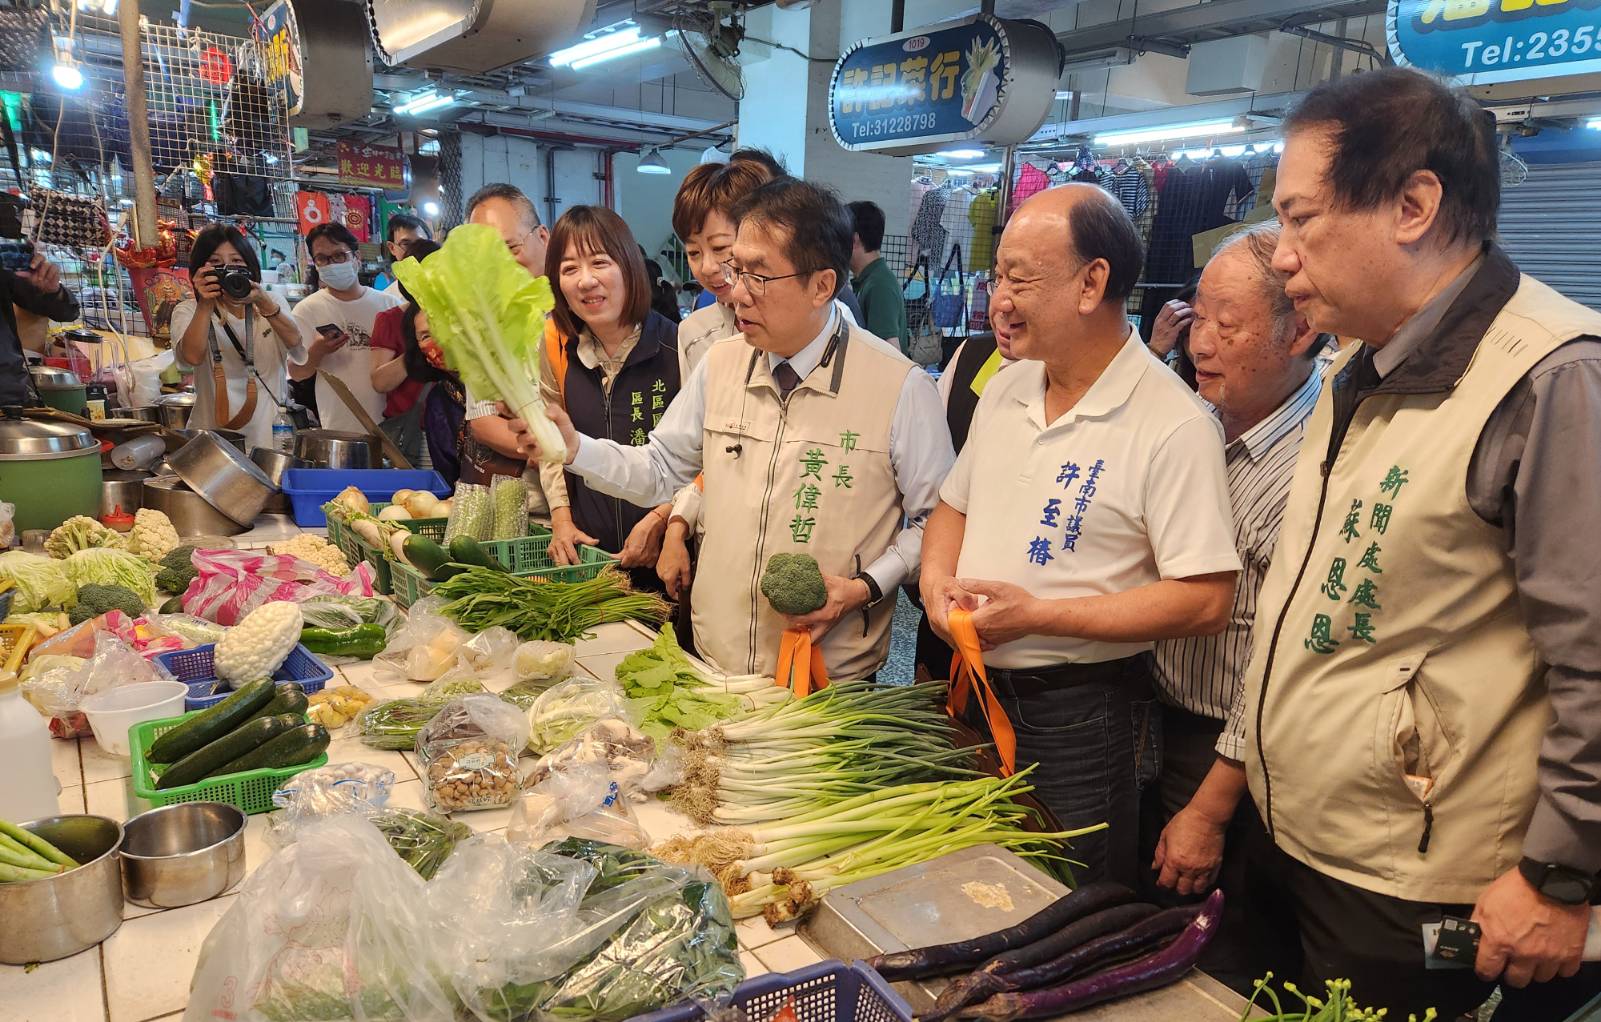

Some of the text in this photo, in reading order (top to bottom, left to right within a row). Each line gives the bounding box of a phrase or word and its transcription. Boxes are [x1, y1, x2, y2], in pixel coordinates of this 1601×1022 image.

[842, 51, 961, 113] 許記菜行
[908, 39, 925, 49] 1019
[852, 112, 936, 138] Tel:31228798
[789, 447, 829, 544] 黃偉哲
[832, 429, 861, 489] 市長
[1061, 458, 1106, 553] 臺南市議員
[1027, 460, 1081, 566] 許至椿
[1347, 465, 1410, 646] 新聞處處長
[1304, 498, 1364, 655] 蘇恩恩
